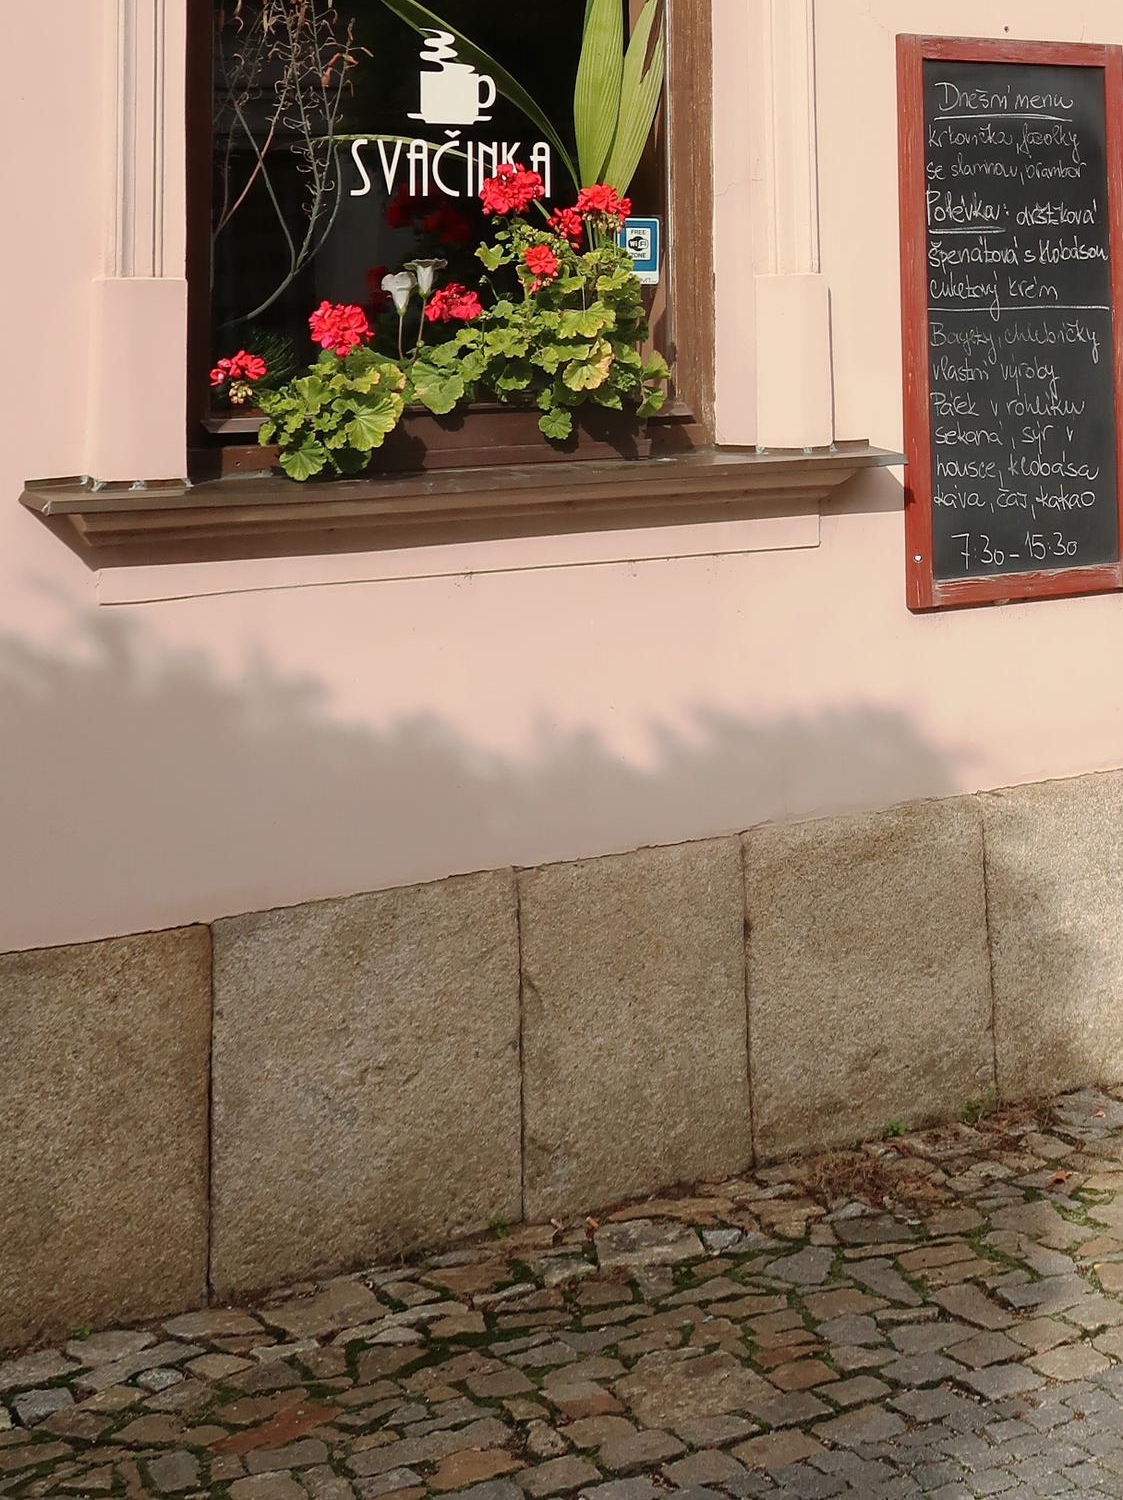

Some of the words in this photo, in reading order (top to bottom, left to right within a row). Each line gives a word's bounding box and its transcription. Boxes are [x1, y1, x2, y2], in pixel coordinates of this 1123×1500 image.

[934, 82, 1011, 112] Dnešní
[1015, 93, 1074, 110] menu
[926, 161, 944, 180] se
[989, 400, 998, 417] v
[1066, 426, 1074, 442] v
